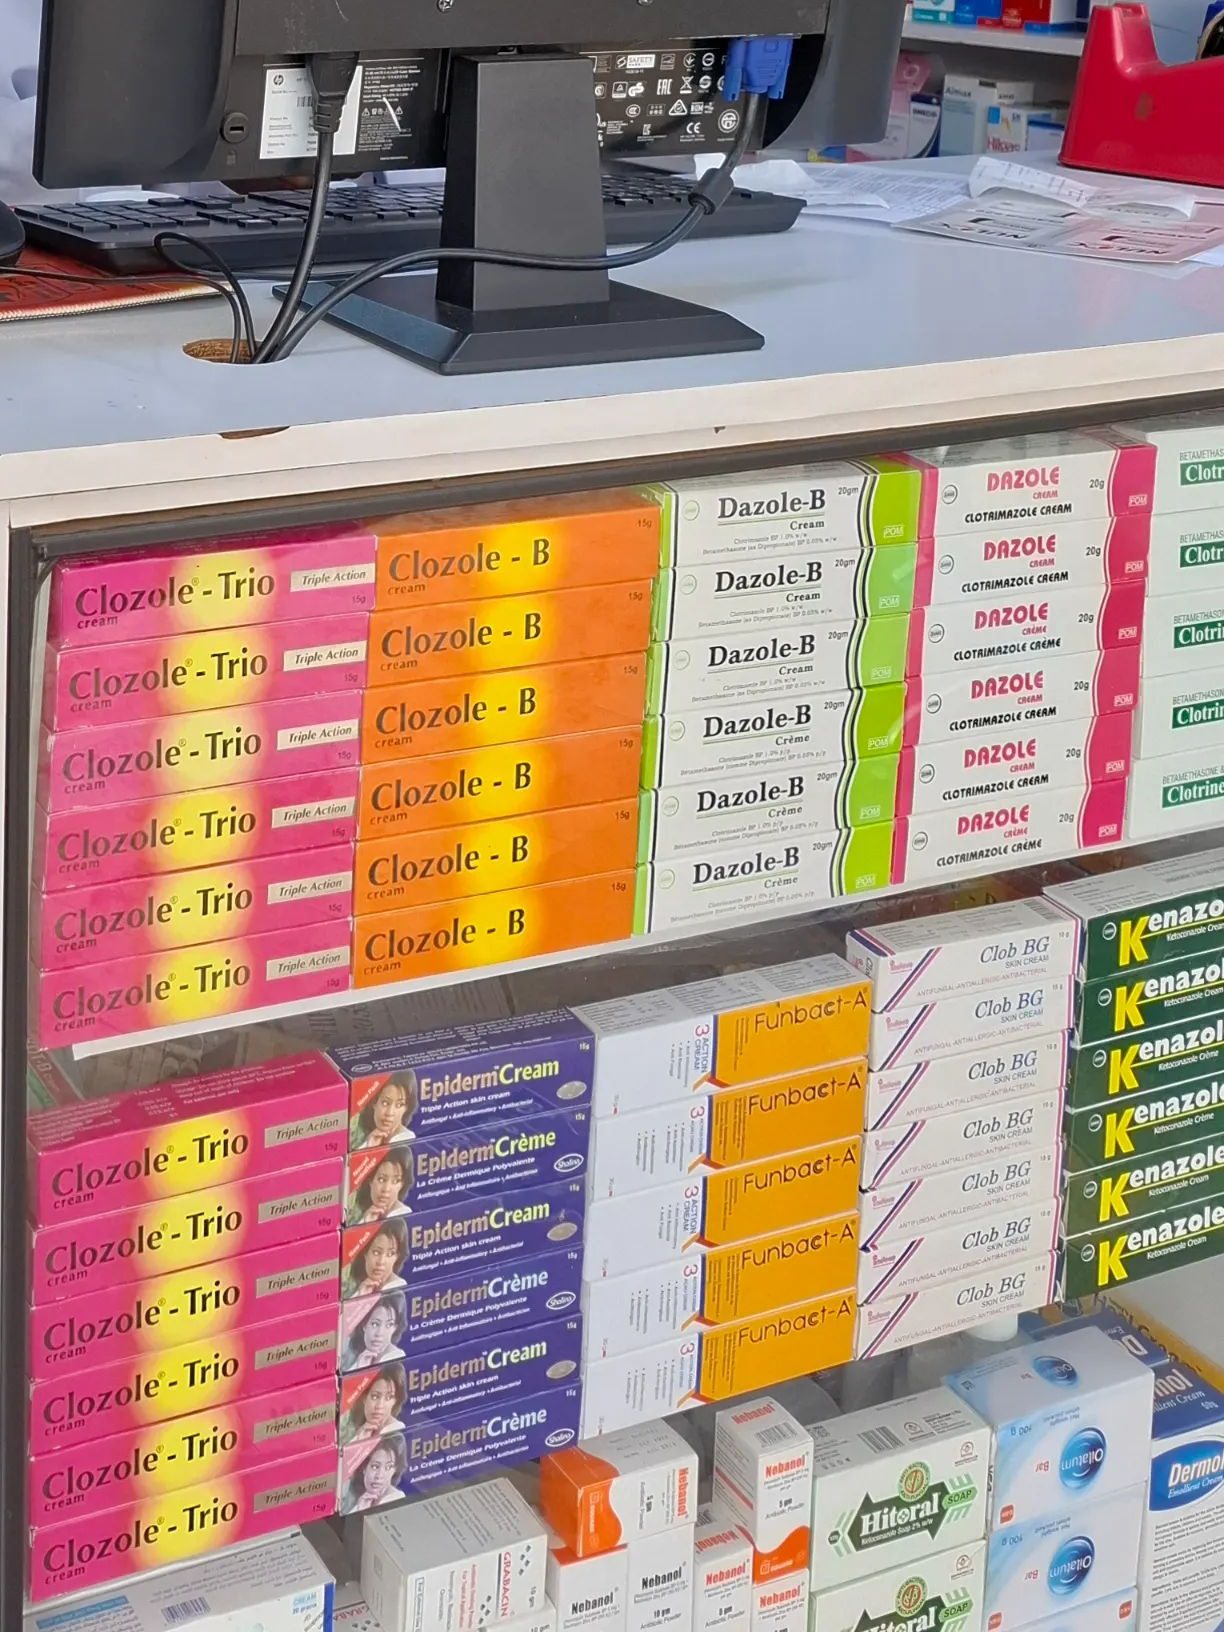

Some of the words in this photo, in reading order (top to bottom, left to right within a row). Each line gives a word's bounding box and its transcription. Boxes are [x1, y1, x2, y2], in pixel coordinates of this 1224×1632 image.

[987, 466, 1060, 493] DAZOLE
[1089, 479, 1105, 489] 20g
[718, 489, 826, 519] Dazole-B
[838, 486, 859, 496] 20gm
[1032, 490, 1058, 500] CREAM
[789, 519, 825, 531] Cream
[964, 507, 1038, 523] CLOTRIMAZOLE
[1040, 503, 1072, 516] CREAM
[884, 526, 904, 537] POM
[388, 543, 500, 581] Clozole
[533, 538, 550, 566] B
[983, 534, 1057, 561] DAZOLE
[301, 573, 330, 586] Triple
[332, 569, 366, 582] Action
[388, 582, 426, 595] cream
[714, 561, 823, 592] Dazole-B
[75, 575, 194, 619] Clozole
[218, 566, 275, 601] Trio
[352, 594, 366, 605] 15g
[77, 616, 118, 630] cream
[974, 602, 1049, 630] DAZOLE
[381, 618, 492, 658] Clozole
[708, 634, 816, 667] Dazole-B
[953, 642, 1027, 661] CLOTRIMAZOLE
[1029, 637, 1062, 651] CRÈME
[69, 657, 188, 701] Clozole
[971, 670, 1045, 699] DAZOLE
[775, 733, 810, 747] Crème
[62, 738, 181, 781] Clozole
[980, 943, 1017, 965] Clob
[1021, 936, 1050, 956] BG
[1005, 959, 1022, 969] SKIN
[1024, 955, 1050, 966] CREAM
[754, 990, 867, 1033] Funbact-A
[974, 996, 1011, 1020] Clob
[1015, 989, 1044, 1011] BG
[695, 1024, 710, 1037] 3
[694, 1039, 702, 1072] CREAM
[700, 1037, 710, 1074] ACTION
[748, 1071, 862, 1115] Funbact-A
[52, 1147, 169, 1197] Clozole
[192, 1128, 249, 1164] Trio
[1189, 1173, 1209, 1186] Cream
[738, 1300, 851, 1347] Funbact-A
[732, 1404, 774, 1426] Nebanol
[765, 1455, 806, 1478] Nebanol
[1061, 1446, 1104, 1472] Oilatum
[42, 1448, 159, 1500] Clozole
[676, 1466, 689, 1518] Nebanol
[947, 1489, 973, 1506] SOAP
[1167, 1478, 1201, 1499] Emollient
[860, 1492, 940, 1537] Hitoral
[697, 1530, 738, 1554] Nebanol
[642, 1569, 683, 1590] Nebanol
[705, 1564, 746, 1586] Nebanol
[1049, 1554, 1093, 1579] Oilatum
[500, 1551, 512, 1618] GRABACIN
[571, 1594, 614, 1616] Nebanol
